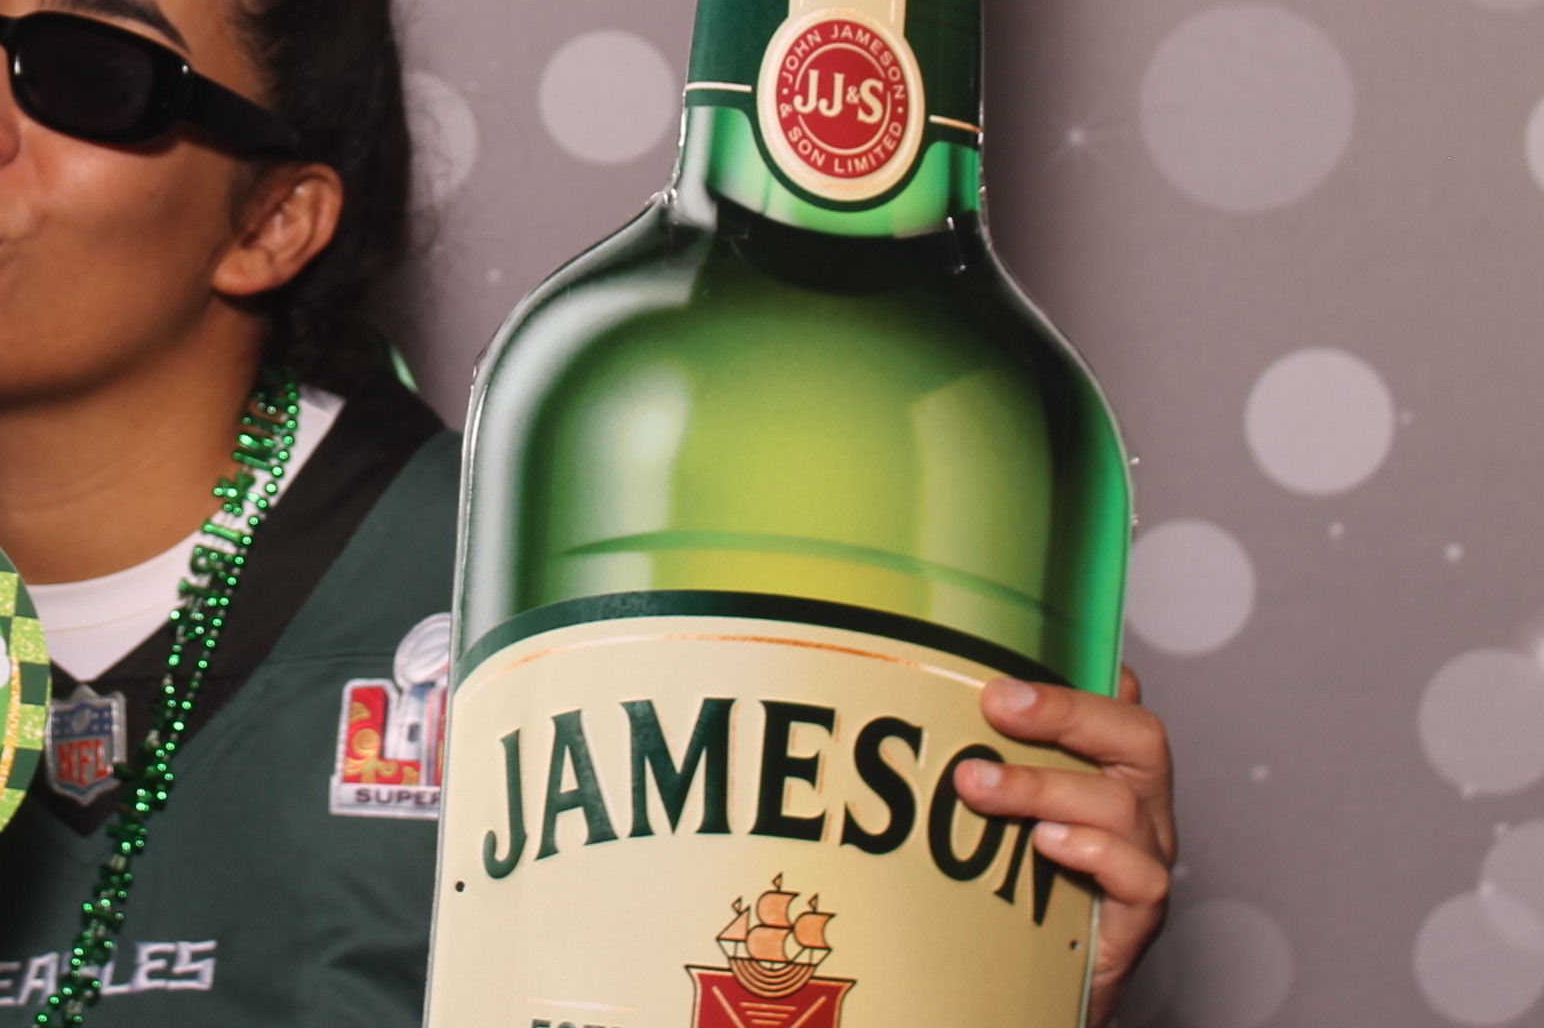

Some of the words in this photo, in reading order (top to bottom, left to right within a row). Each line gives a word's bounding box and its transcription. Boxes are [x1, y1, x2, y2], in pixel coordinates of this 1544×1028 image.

[781, 29, 823, 85] JOHN
[830, 24, 906, 100] JAMESON
[787, 126, 827, 168] SON
[833, 121, 904, 174] LIMITED
[58, 739, 114, 787] NFL
